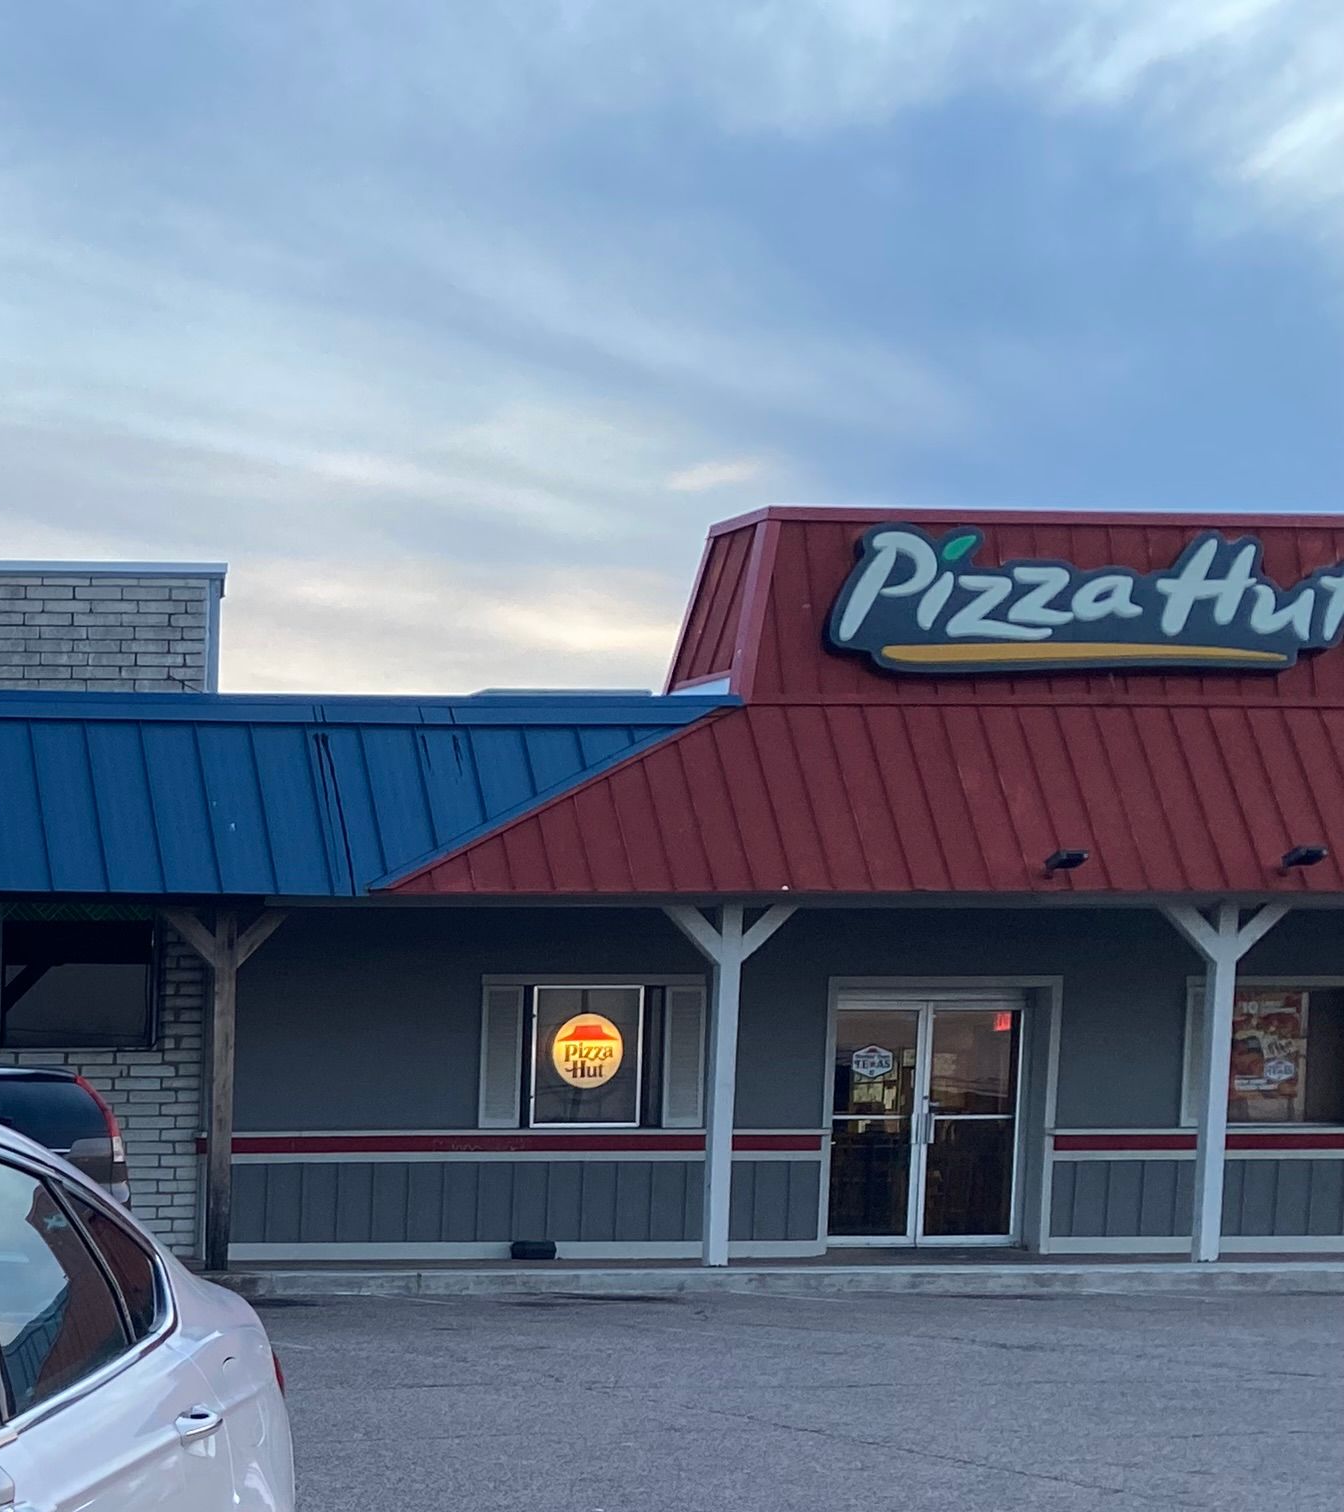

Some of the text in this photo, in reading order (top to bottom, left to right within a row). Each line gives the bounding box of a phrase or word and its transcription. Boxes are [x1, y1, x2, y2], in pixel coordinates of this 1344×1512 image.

[838, 530, 1143, 641] Pizza
[564, 1042, 613, 1062] Pizza
[565, 1060, 603, 1078] Hut
